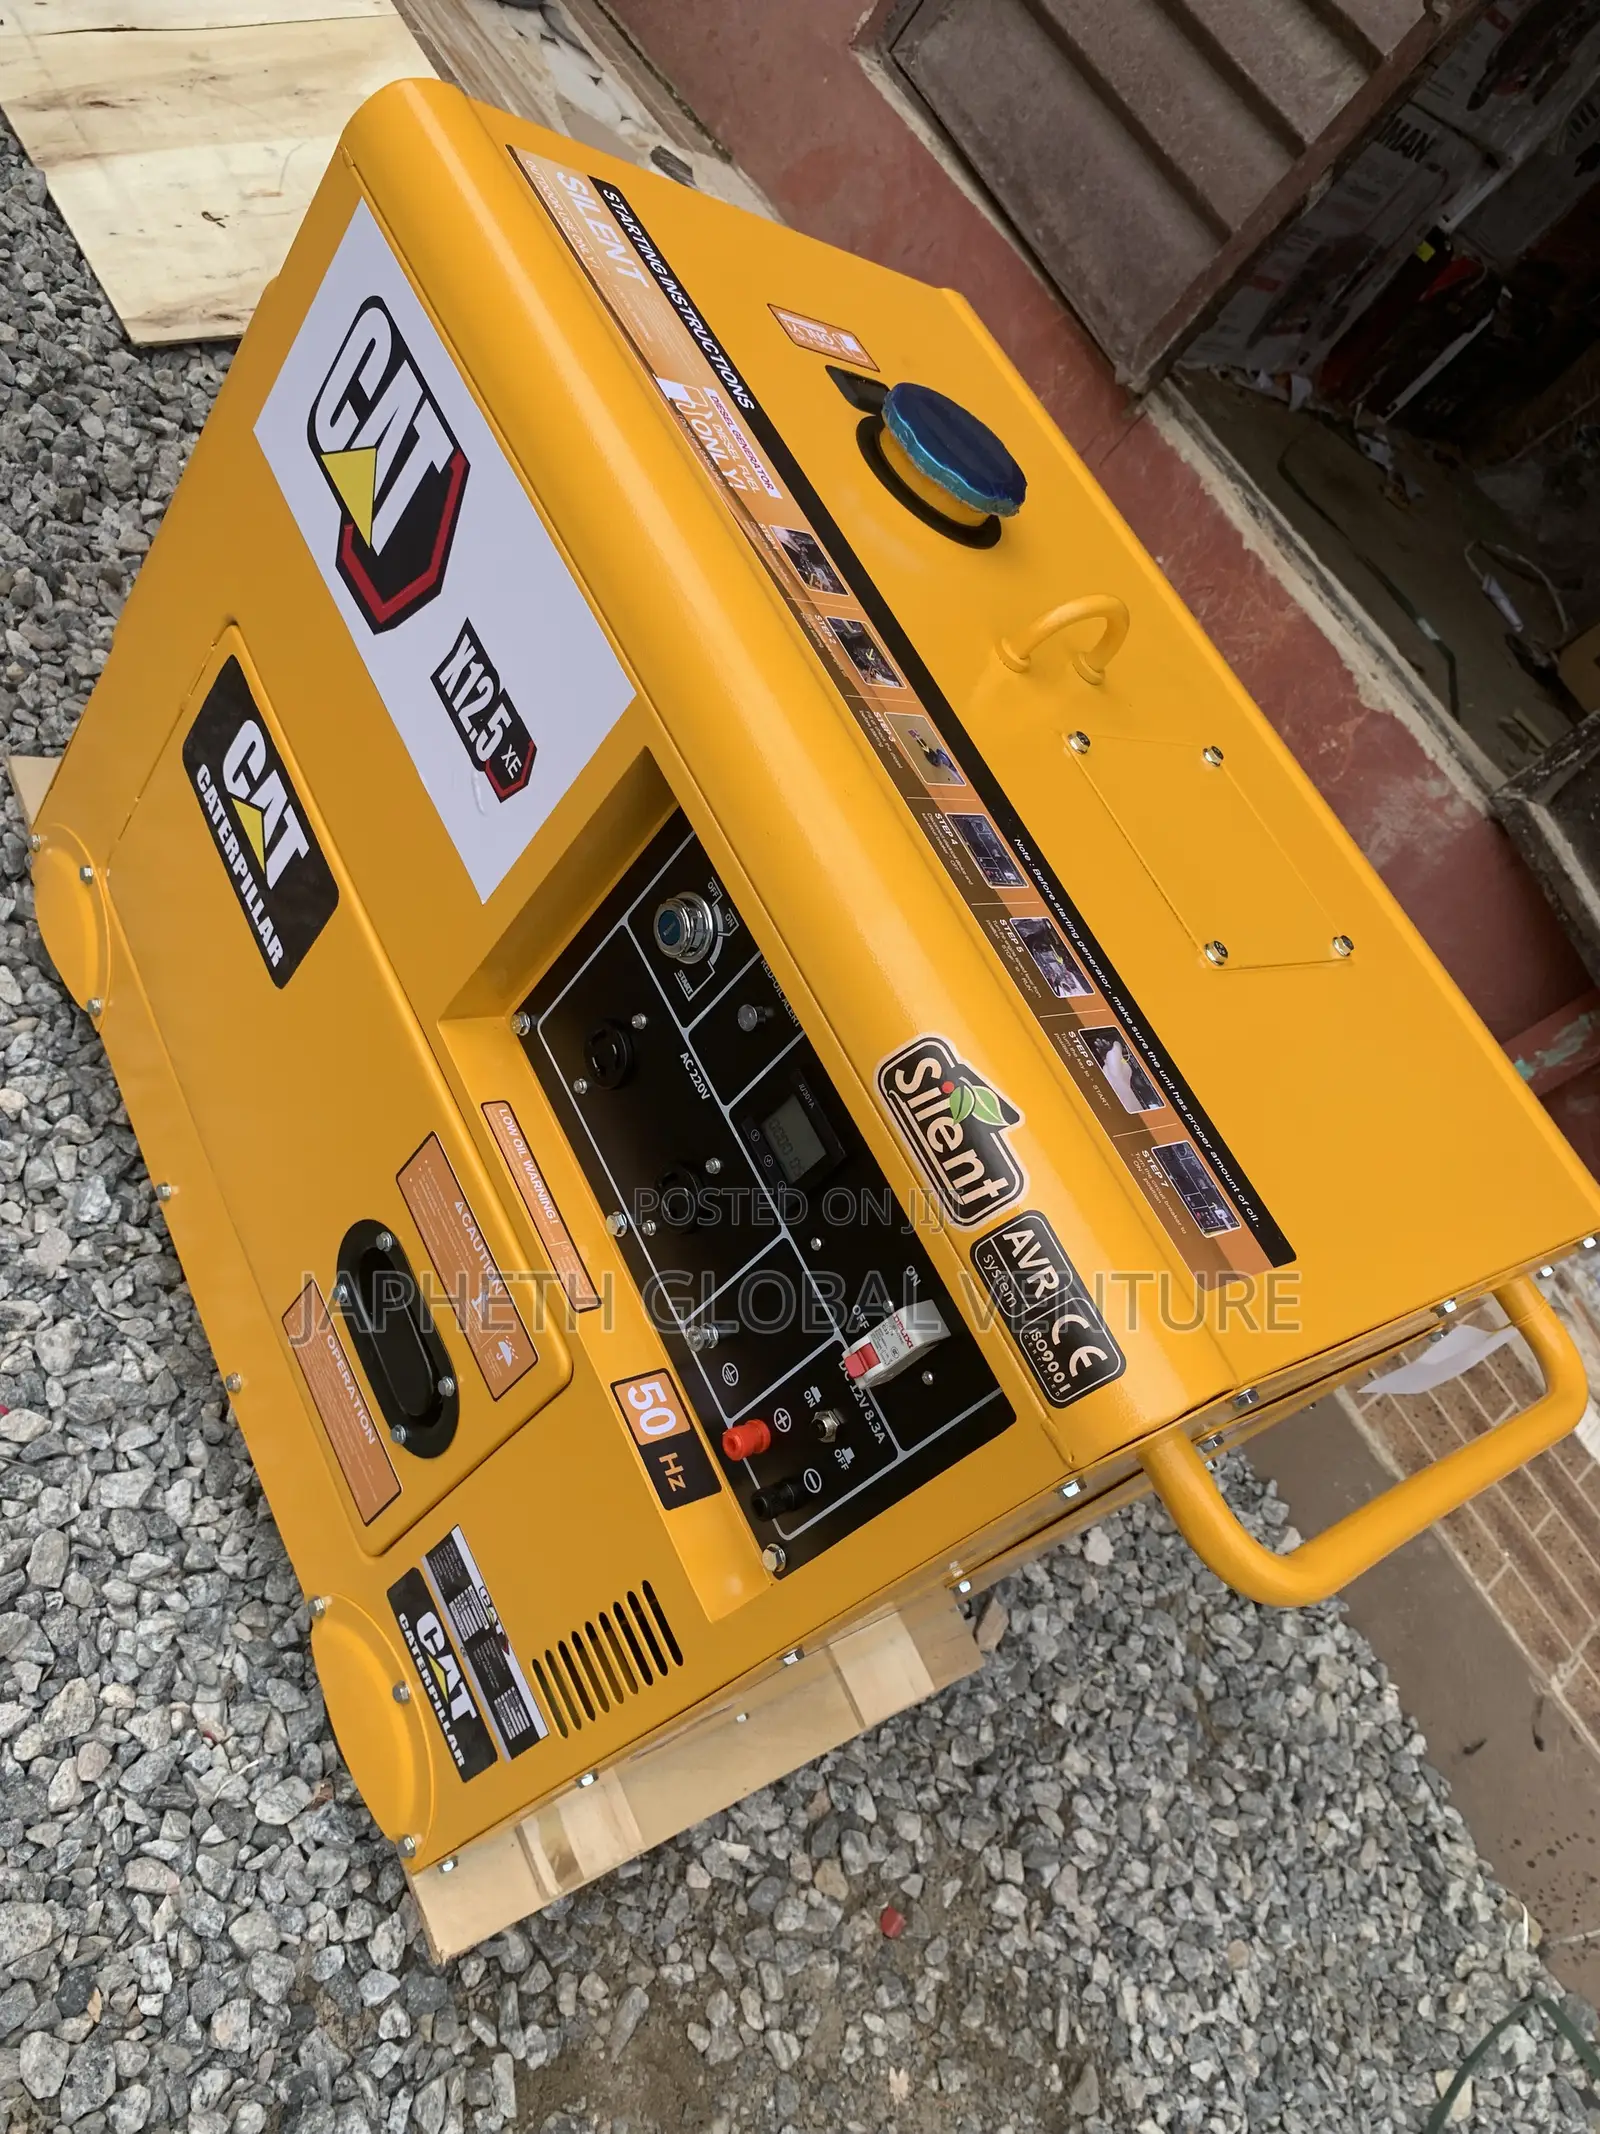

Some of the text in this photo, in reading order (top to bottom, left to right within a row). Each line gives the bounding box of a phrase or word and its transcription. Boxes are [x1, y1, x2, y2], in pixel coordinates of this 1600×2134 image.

[524, 160, 563, 211] OUTDOOR
[556, 211, 577, 234] USE
[555, 173, 649, 287] SILENT
[601, 190, 668, 273] STARTING
[658, 277, 755, 408] INSTRUCTIONS
[315, 307, 454, 556] CAT
[689, 418, 748, 492] ONLY!
[709, 395, 775, 489] DIESEL GENERATOR
[710, 423, 761, 491] DIESEL FUEL
[758, 523, 776, 544] STEP
[813, 614, 832, 637] STEP
[437, 632, 523, 780] X12.5 XE
[872, 711, 892, 735] STEP
[222, 719, 310, 890] CAT
[933, 812, 958, 846] STEP 4
[196, 763, 284, 967] CATERPILLAR
[704, 880, 721, 898] OFF
[721, 912, 737, 928] ON
[998, 919, 1025, 953] STEP 5
[675, 969, 694, 995] START
[1012, 838, 1032, 860] Note
[1031, 867, 1057, 900] Before
[1051, 901, 1081, 939] starting
[1075, 938, 1112, 990] generator
[1111, 995, 1135, 1024] make
[1130, 1025, 1150, 1050] sure
[1146, 1050, 1162, 1068] the
[1157, 1069, 1176, 1090] unit
[1171, 1090, 1189, 1111] has
[1184, 1112, 1213, 1150] proper
[1209, 1149, 1241, 1193] amount
[1236, 1192, 1250, 1207] of
[1245, 1206, 1259, 1222] oil
[1059, 1032, 1072, 1047] Turn
[1068, 1047, 1079, 1057] the
[1074, 1057, 1086, 1070] key
[1066, 1031, 1095, 1067] STEP 6
[678, 1052, 711, 1100] AC 220V
[895, 1057, 1009, 1205] Silent
[497, 1107, 560, 1225] LOW OIL WARNING!
[1133, 1152, 1187, 1234] Turn the circuit breaker to
[1139, 1150, 1169, 1189] STEP 7
[1141, 1176, 1164, 1204] position
[458, 1212, 504, 1297] CAUTION
[901, 1264, 923, 1287] ON
[983, 1252, 1018, 1309] system
[1003, 1229, 1060, 1300] AVR
[849, 1303, 871, 1331] OFF
[891, 1313, 914, 1349] DELIXI
[322, 1334, 377, 1445] OPERATION
[1024, 1334, 1061, 1397] CERTIFIED
[1028, 1328, 1071, 1393] ISO9001
[800, 1389, 818, 1408] ON
[848, 1381, 869, 1407] 12V
[862, 1408, 886, 1444] 8.3A
[624, 1380, 687, 1492] 50 Hz
[831, 1448, 850, 1472] OFF
[479, 1586, 505, 1643] CAT
[398, 1613, 464, 1767] CATERPILLAR
[416, 1611, 477, 1720] CAT
